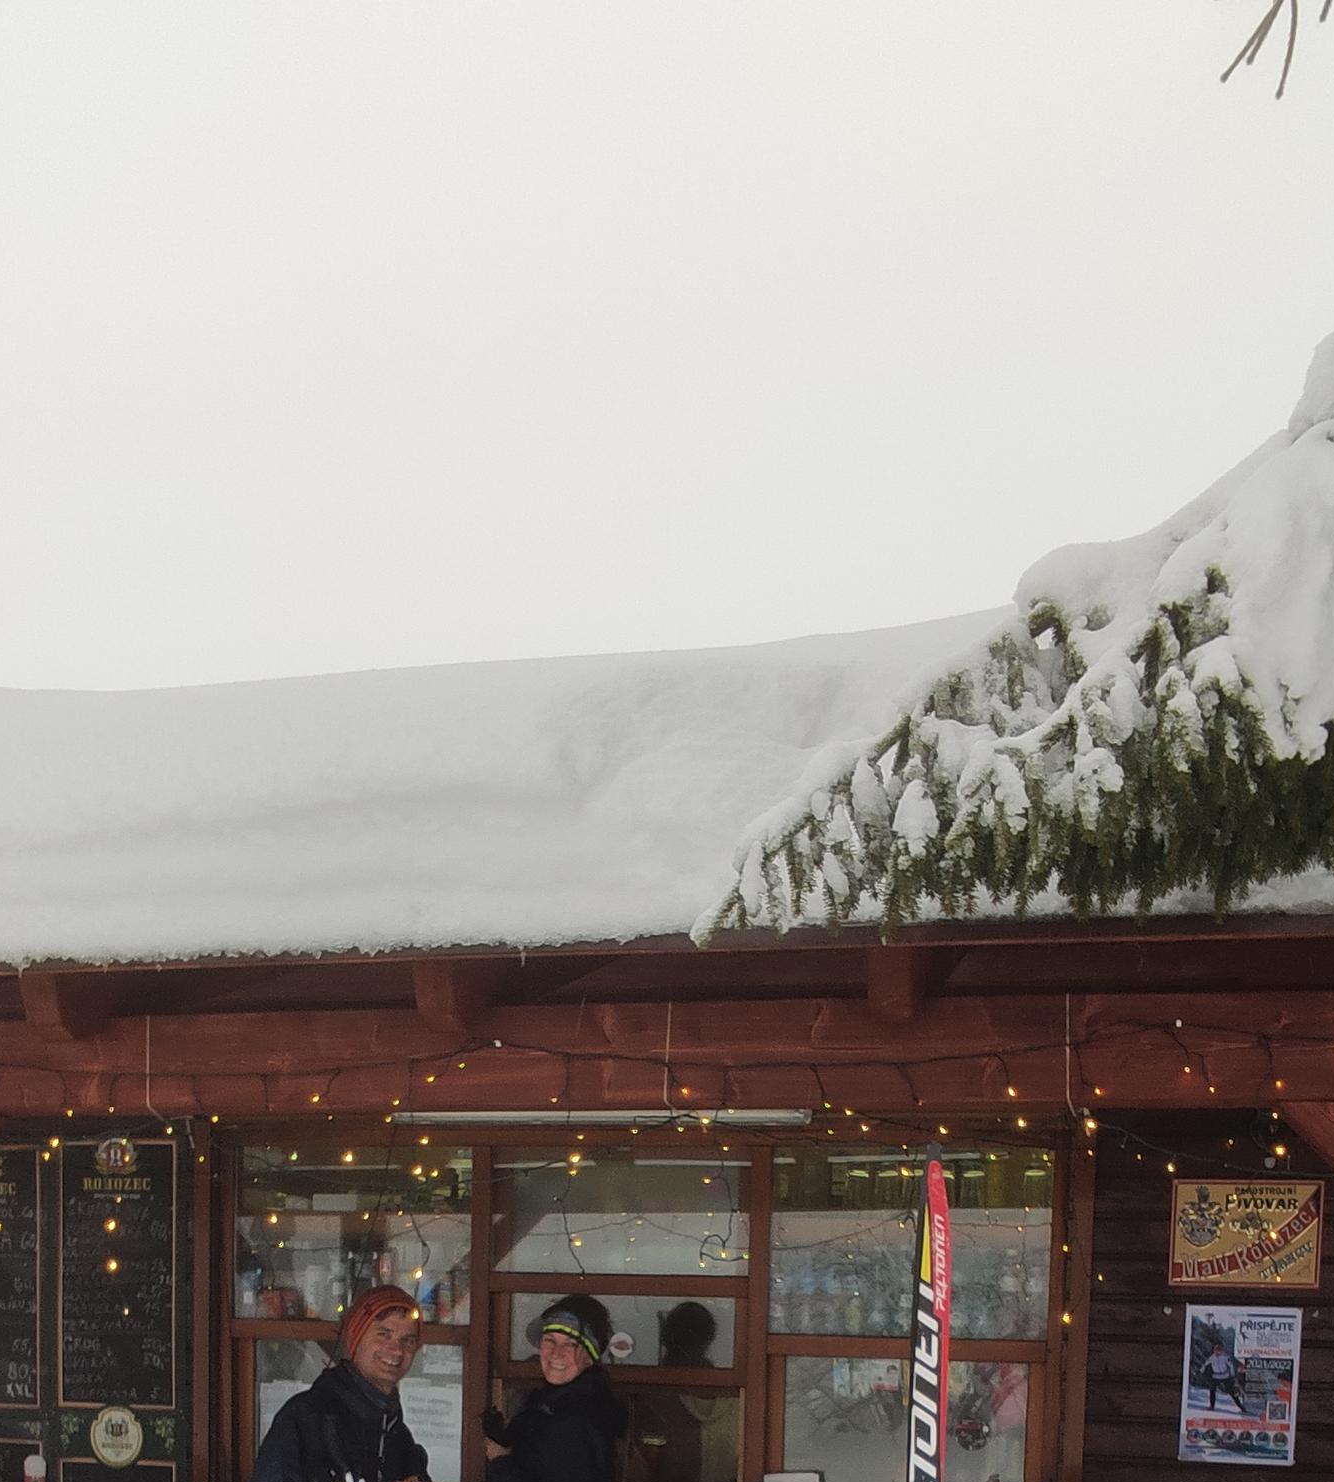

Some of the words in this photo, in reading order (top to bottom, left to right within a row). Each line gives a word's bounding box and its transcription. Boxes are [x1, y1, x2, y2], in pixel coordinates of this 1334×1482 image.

[1225, 1193, 1299, 1212] PIVOVAR
[933, 1212, 948, 1313] PELTONEN
[1240, 1319, 1295, 1332] PŘISPĚJTE
[1247, 1359, 1292, 1369] 2021/2022
